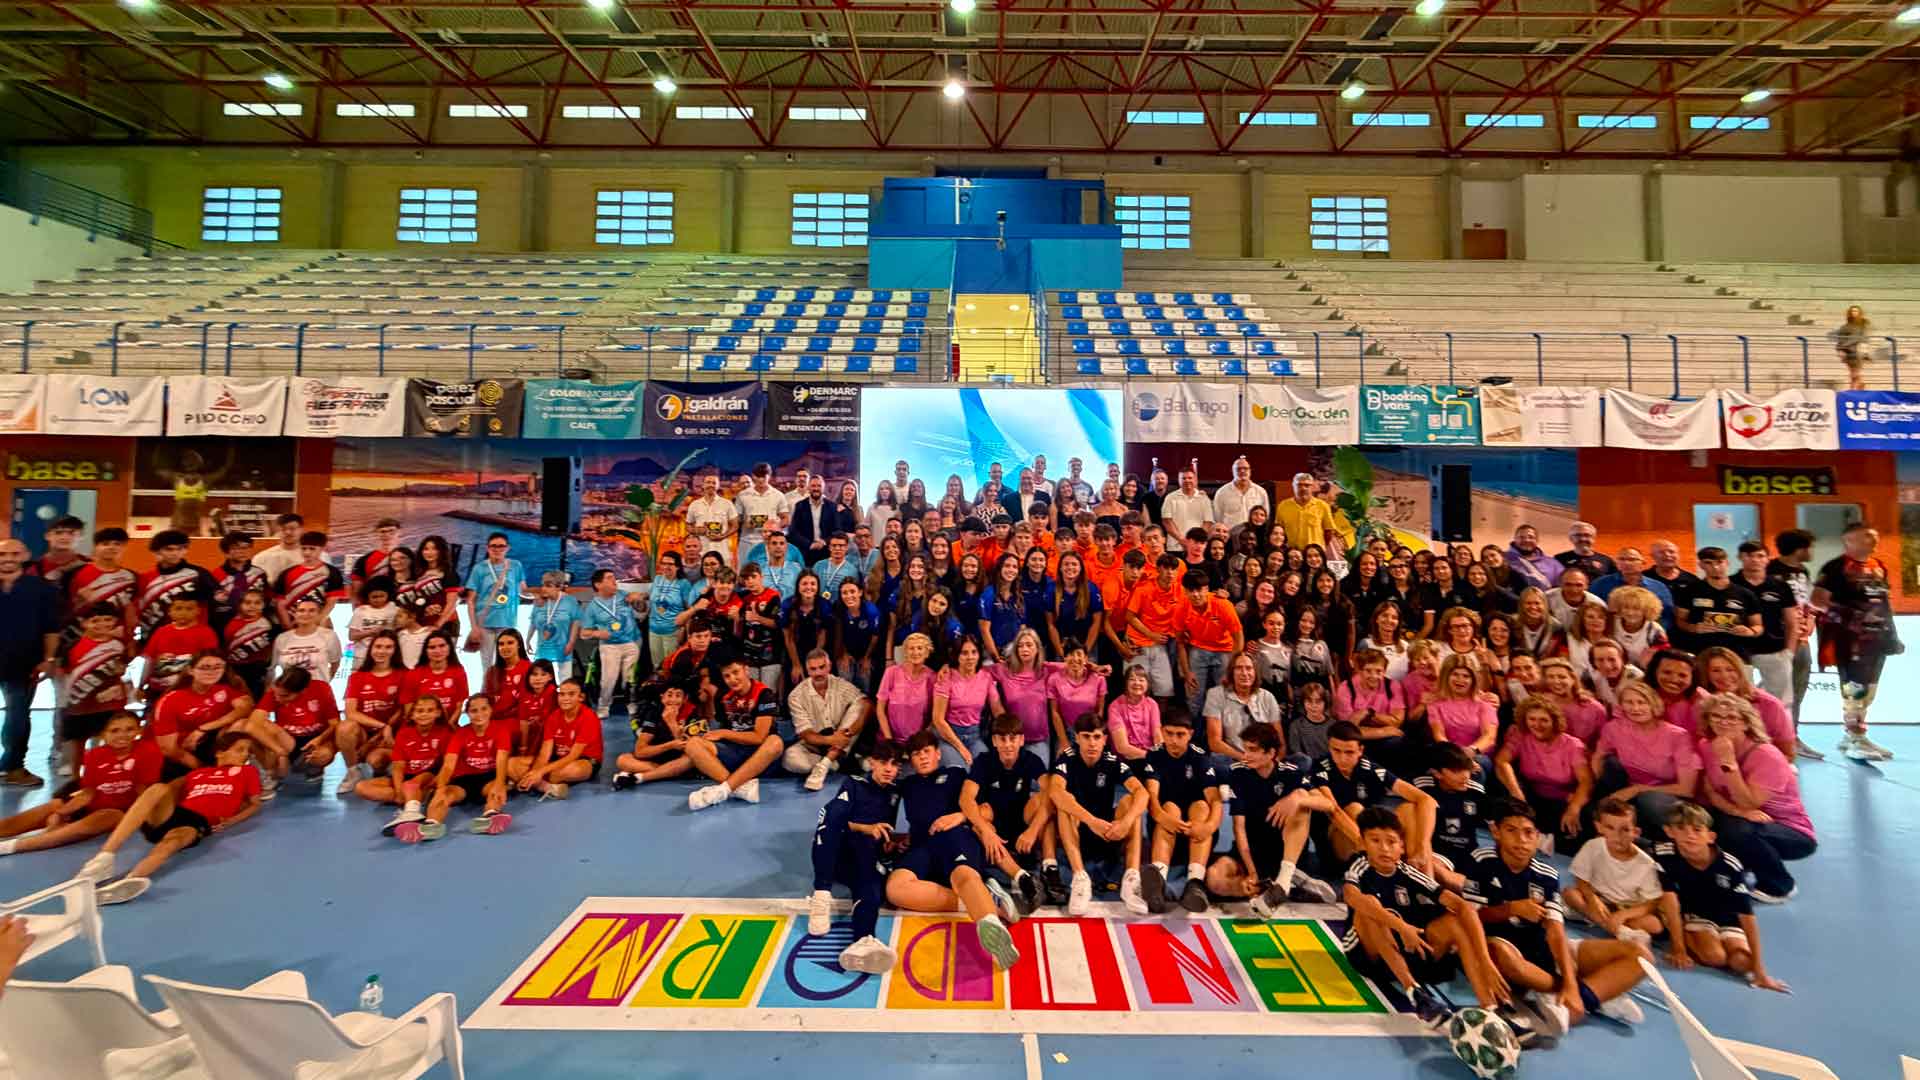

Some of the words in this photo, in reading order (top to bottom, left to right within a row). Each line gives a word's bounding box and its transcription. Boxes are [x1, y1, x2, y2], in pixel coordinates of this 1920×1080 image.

[810, 387, 859, 396] DENMARC
[1383, 389, 1429, 405] booking
[425, 393, 476, 408] pascual
[1383, 402, 1411, 411] vans
[512, 912, 1370, 1008] ENIDORM
